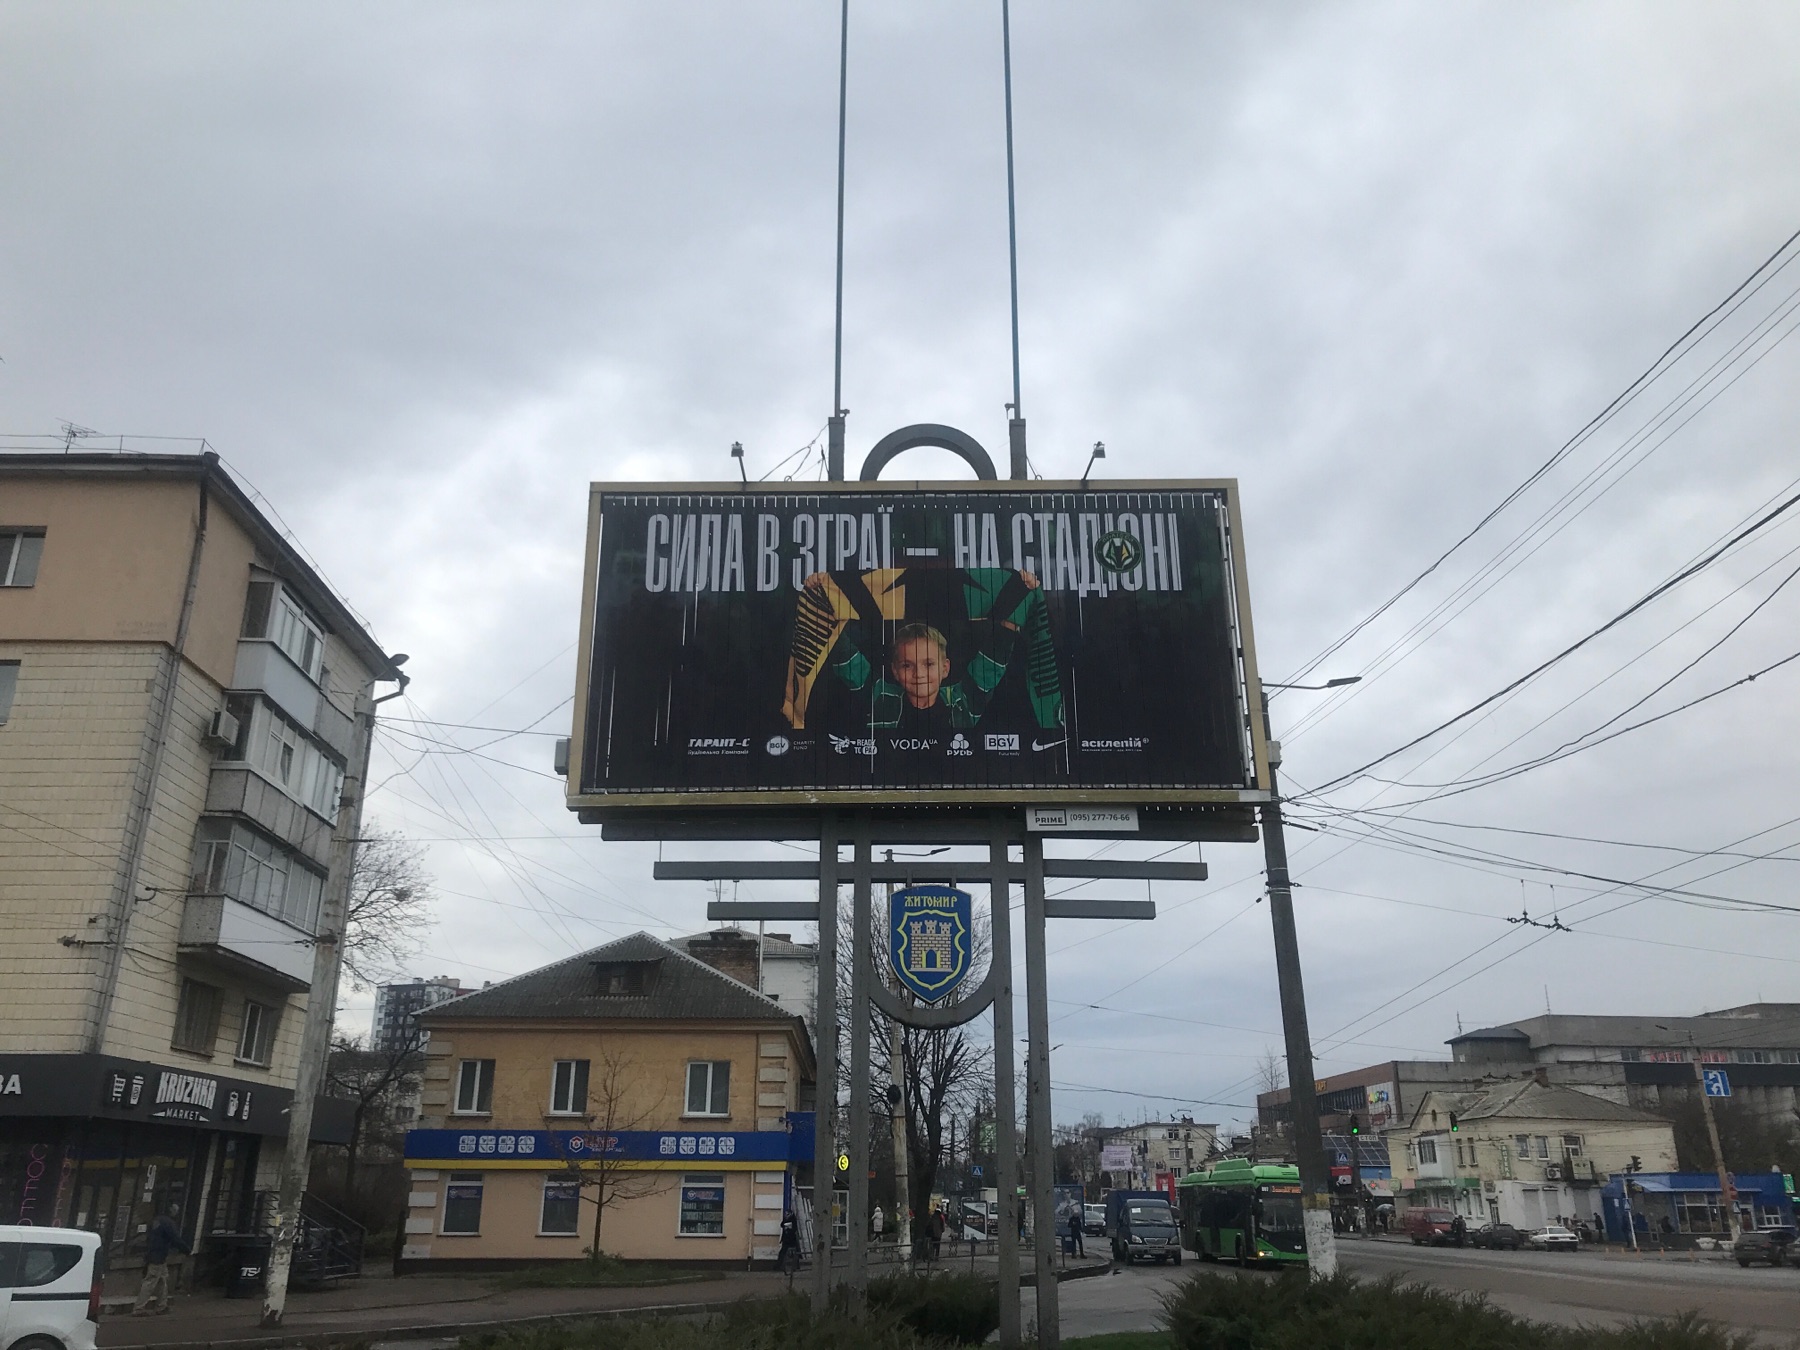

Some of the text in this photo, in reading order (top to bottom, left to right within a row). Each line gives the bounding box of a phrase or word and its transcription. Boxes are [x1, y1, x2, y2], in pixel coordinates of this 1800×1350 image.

[645, 513, 745, 592] СИЛА
[756, 513, 780, 592] В
[792, 506, 894, 592] ЗГРАЇ
[954, 513, 1000, 568] НА
[988, 737, 1015, 747] BGV
[1069, 813, 1090, 822] (095)
[1091, 813, 1130, 822] 277-76-66
[904, 895, 958, 908] ЖИТОМИР
[155, 1071, 218, 1110] KRUZHKA
[165, 1108, 200, 1121] MARKET
[1502, 1145, 1511, 1177] АПТЕКА
